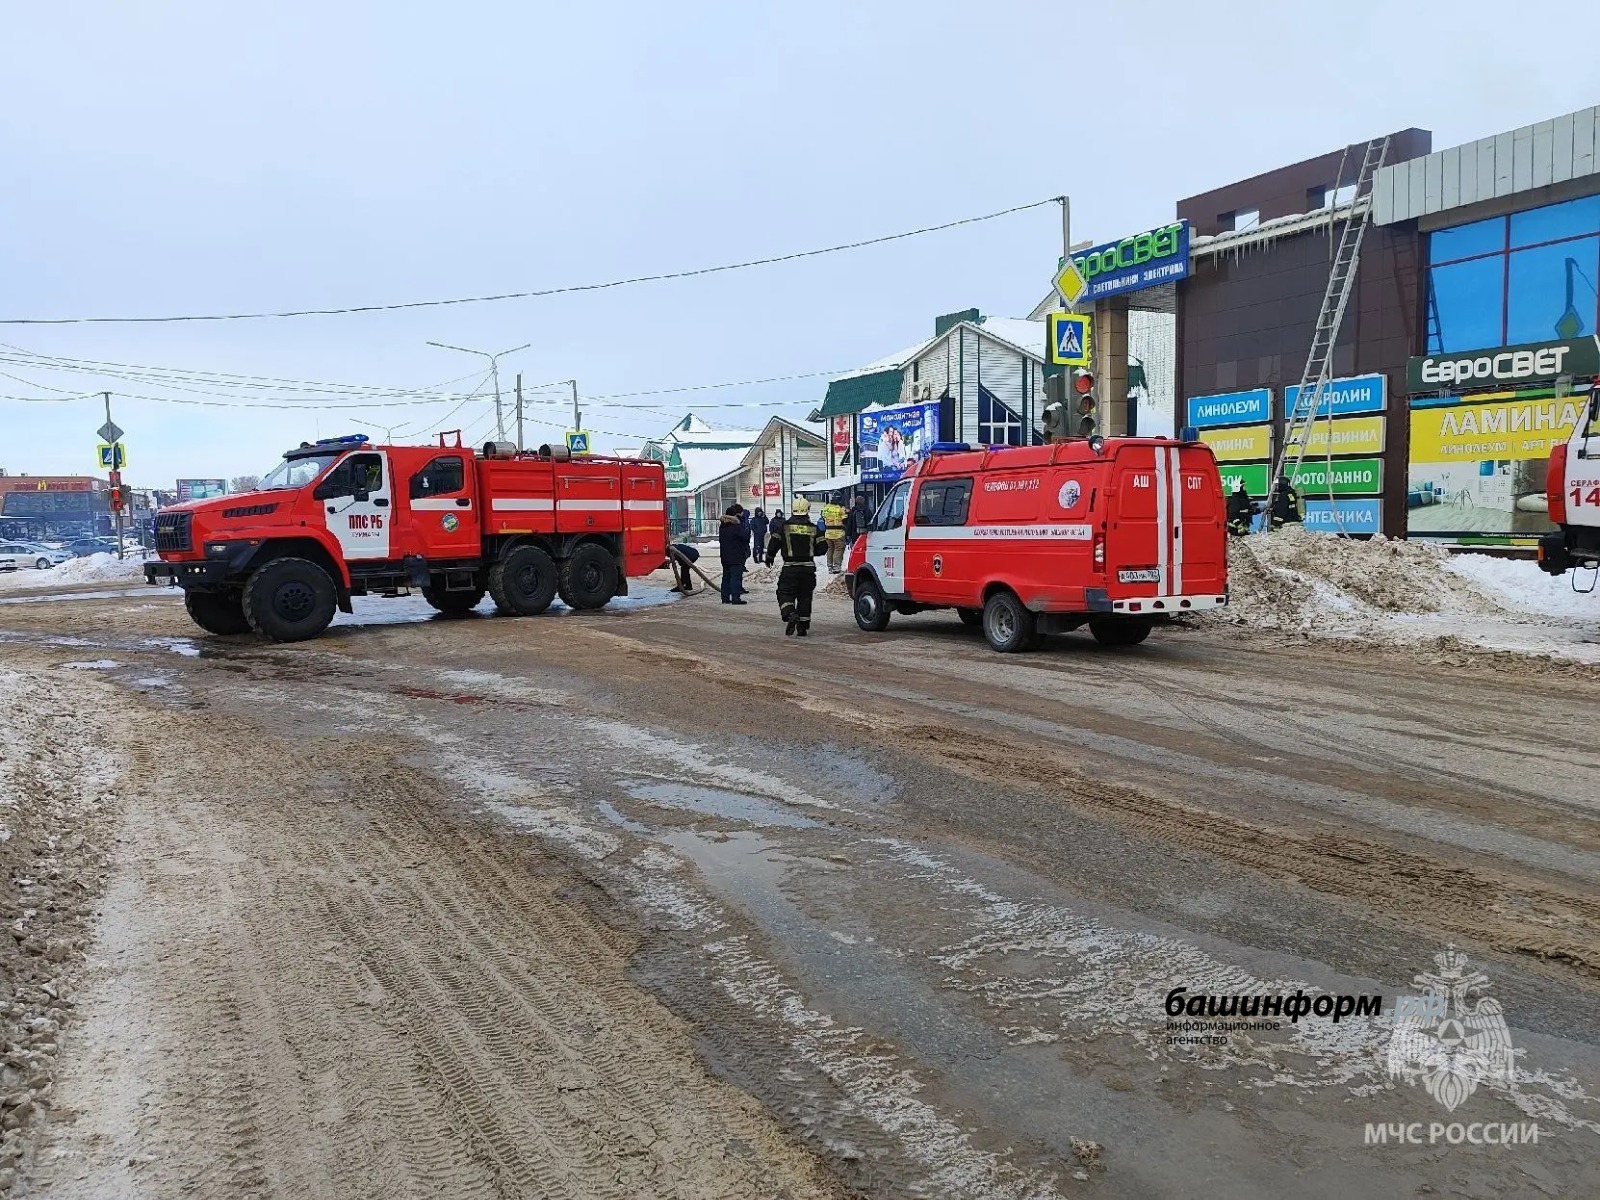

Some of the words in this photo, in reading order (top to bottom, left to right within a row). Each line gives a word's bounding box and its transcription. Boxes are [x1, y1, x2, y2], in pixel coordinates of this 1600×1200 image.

[1058, 223, 1183, 282] роСВЕТ
[1299, 387, 1371, 408] ОРОЛИН
[1197, 400, 1261, 418] ЛИНОЛЕУМ
[1440, 403, 1584, 437] ЛАМИНА
[1209, 437, 1254, 451] АМИНАТ
[1521, 439, 1546, 451] АРТ
[1133, 474, 1149, 488] АШ
[1187, 476, 1202, 489] СПТ
[1569, 487, 1600, 507] 14
[348, 514, 369, 529] ППС
[370, 514, 383, 529] РБ
[1302, 509, 1374, 524] НТЕХНИКА
